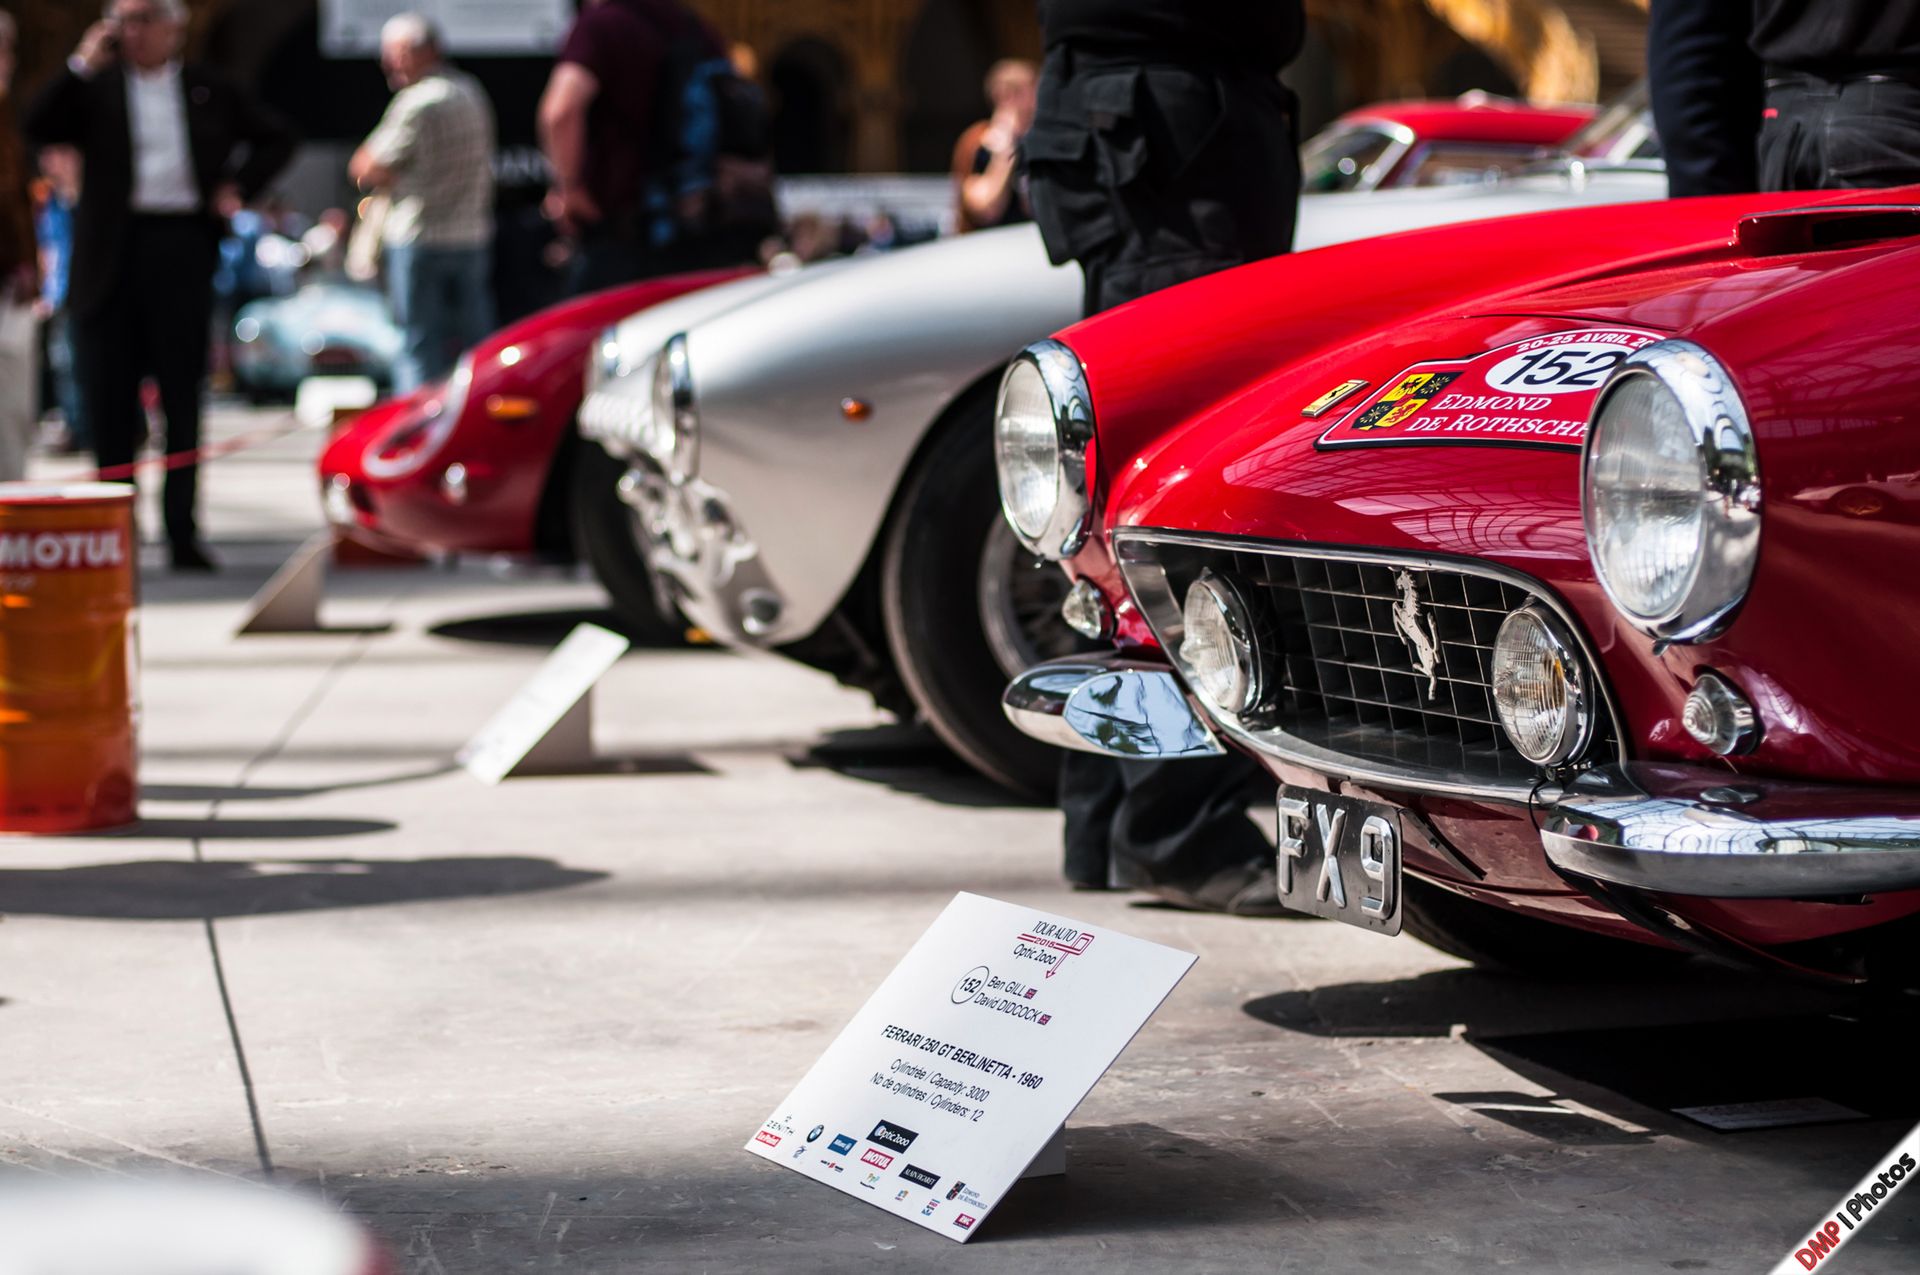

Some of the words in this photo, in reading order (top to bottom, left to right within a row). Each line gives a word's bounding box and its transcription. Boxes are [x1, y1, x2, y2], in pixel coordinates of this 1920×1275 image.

[1516, 334, 1574, 353] 20-25
[1576, 332, 1631, 344] AVRIL
[1500, 349, 1628, 386] 152
[1430, 393, 1552, 411] EDMOND
[1404, 416, 1449, 432] DE
[0, 532, 123, 569] MOTUL
[1360, 815, 1395, 920] 9
[1032, 920, 1057, 937] TOUR
[1052, 927, 1078, 942] AUTO
[1013, 943, 1037, 959] Optic
[959, 977, 982, 994] 152
[987, 975, 1006, 991] Ben
[1004, 981, 1026, 997] GILL
[973, 992, 1002, 1009] David
[996, 999, 1042, 1023] DIDCOCK
[881, 1024, 925, 1048] FERRARI
[919, 1037, 941, 1053] 250
[937, 1043, 956, 1058] GT
[950, 1048, 1014, 1080] BERLINETTA
[1017, 1071, 1044, 1090] 1960
[890, 1058, 927, 1080] Cylindrée
[929, 1072, 967, 1096] Capacity:
[965, 1085, 990, 1102] 3000
[870, 1072, 884, 1085] Nb
[881, 1077, 895, 1089] de
[892, 1082, 928, 1101] cylindres
[930, 1094, 971, 1118] Cylinders:
[970, 1109, 984, 1122] 12
[766, 1120, 795, 1136] ZENITH
[863, 1150, 890, 1168] MOTUL
